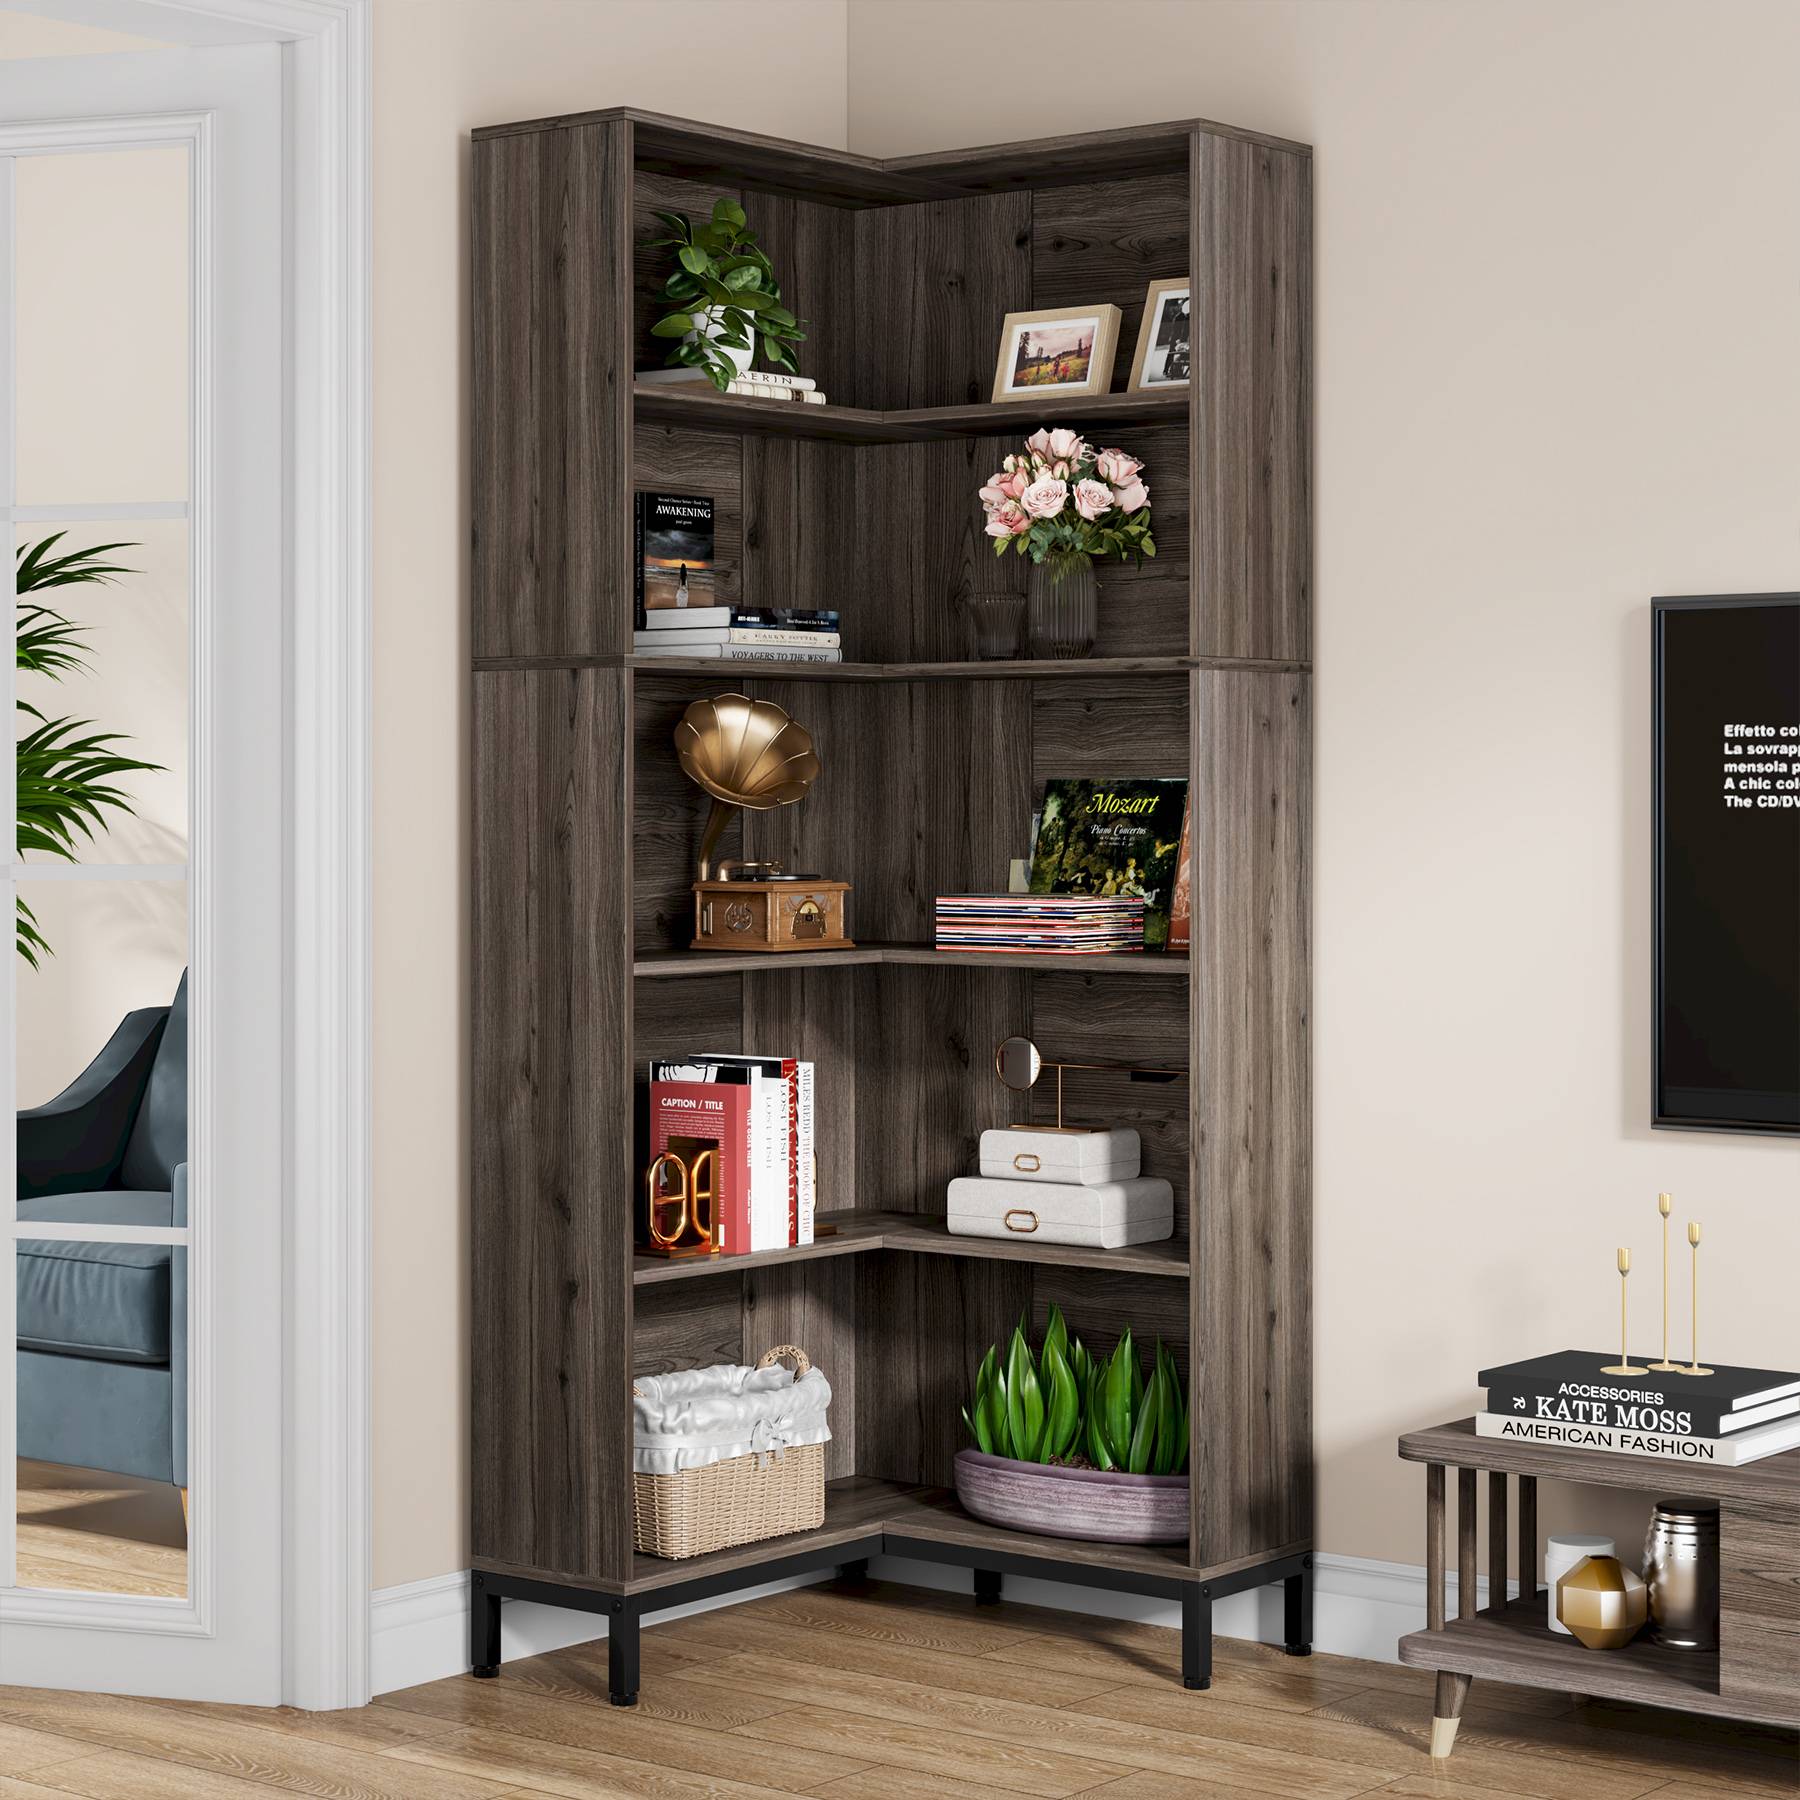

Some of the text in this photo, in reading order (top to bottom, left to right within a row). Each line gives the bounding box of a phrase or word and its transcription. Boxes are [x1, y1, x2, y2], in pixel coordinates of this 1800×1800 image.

[737, 371, 792, 385] AERIN
[656, 505, 711, 519] AWAKENING
[732, 650, 774, 660] VOYAGERS
[1724, 724, 1776, 737] Effetto
[1724, 742, 1800, 757] La sovrap
[1724, 760, 1788, 773] mensola
[1724, 777, 1736, 790] A
[1739, 777, 1772, 790] chic
[1086, 793, 1160, 814] Mozart
[1724, 795, 1752, 808] The
[1090, 824, 1146, 836] Piano Concertos
[802, 1068, 811, 1102] MILES
[662, 1098, 696, 1108] CAPTION
[704, 1100, 724, 1110] TITLE
[802, 1103, 811, 1134] REDD
[802, 1136, 811, 1159] THE
[802, 1162, 811, 1192] BOOK
[802, 1194, 811, 1207] OF
[1558, 1382, 1664, 1405] ACCESSORIES
[1535, 1396, 1608, 1425] KATE
[1614, 1404, 1692, 1434] MOSS
[1502, 1422, 1714, 1458] AMERICAN FASHION
